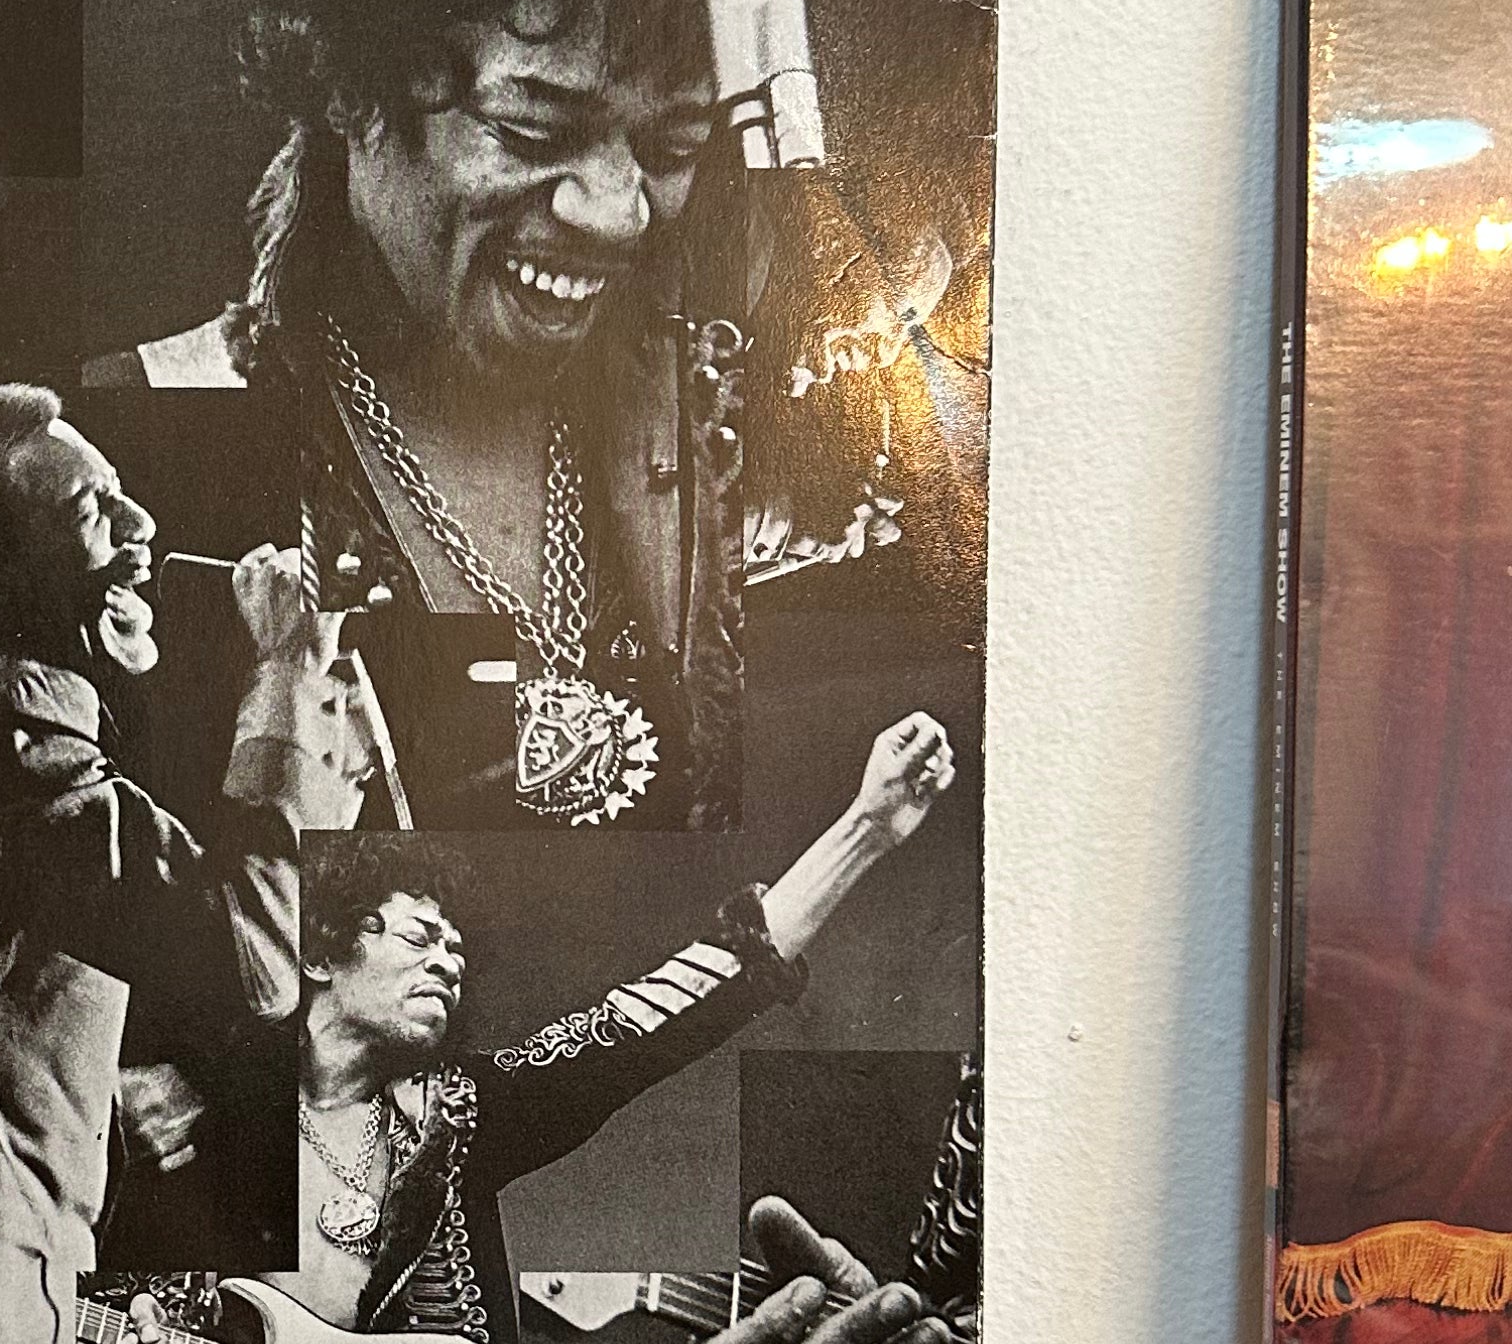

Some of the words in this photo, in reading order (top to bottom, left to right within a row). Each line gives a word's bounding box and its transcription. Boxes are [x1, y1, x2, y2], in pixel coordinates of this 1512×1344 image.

[1282, 321, 1292, 384] THE
[1278, 394, 1291, 518] EMINEM
[1276, 528, 1289, 624] SHOW
